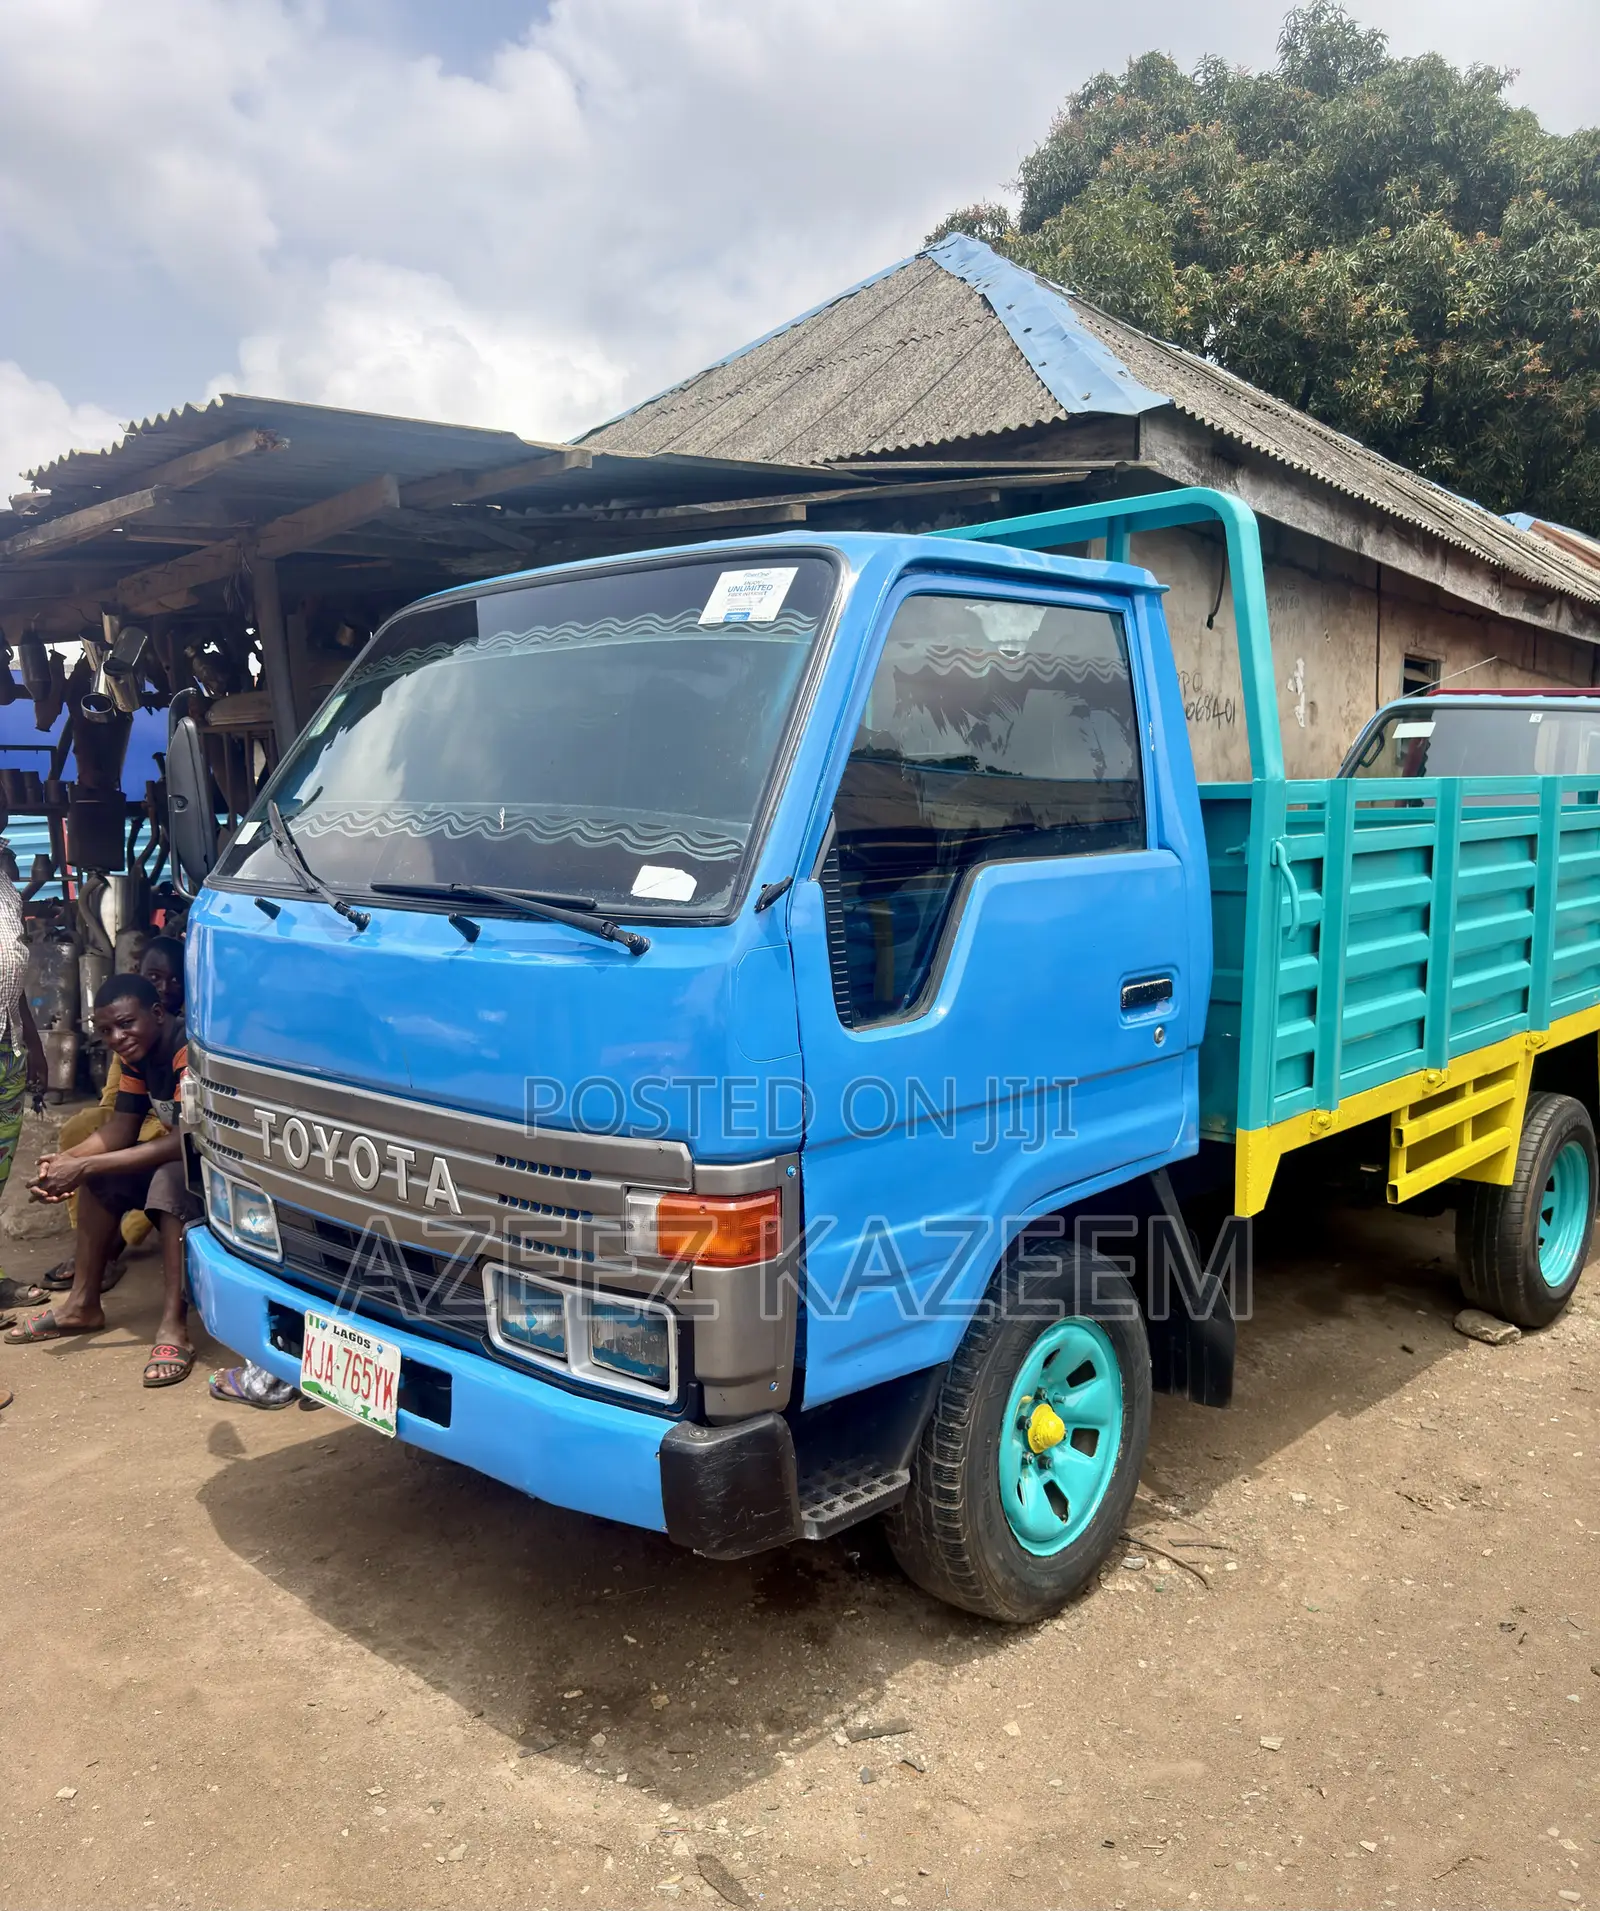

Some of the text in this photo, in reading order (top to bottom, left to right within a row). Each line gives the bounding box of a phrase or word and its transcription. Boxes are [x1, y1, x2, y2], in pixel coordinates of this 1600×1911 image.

[727, 584, 774, 593] UNLIMITED
[254, 1108, 464, 1216] TOYOTA
[333, 1325, 371, 1349] LAGOS
